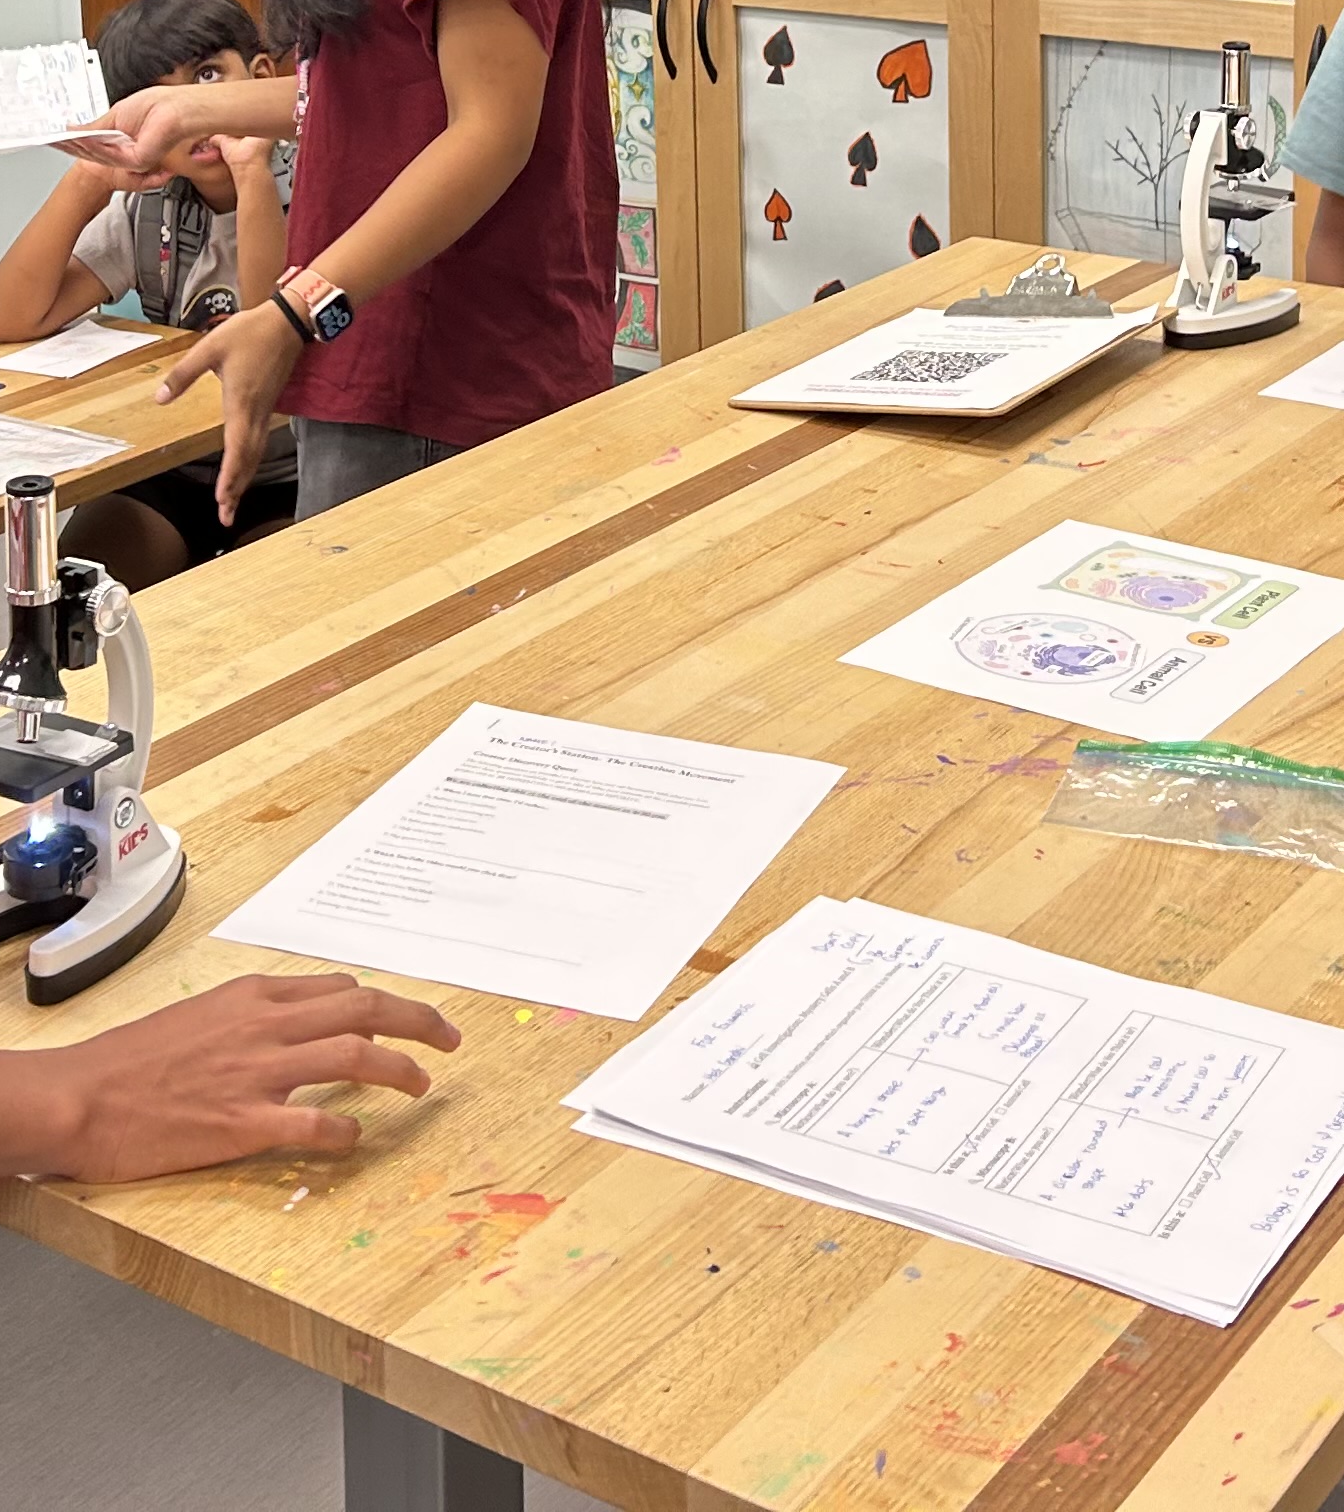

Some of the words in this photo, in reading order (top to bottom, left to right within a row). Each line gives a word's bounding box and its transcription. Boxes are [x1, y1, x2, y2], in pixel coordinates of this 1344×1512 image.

[1235, 603, 1261, 620] Cell
[1251, 589, 1281, 610] Plant
[1153, 655, 1188, 683] Animal
[1130, 678, 1158, 696] Cell
[489, 737, 509, 745] The
[607, 757, 626, 765] The
[119, 823, 148, 860] KIDS
